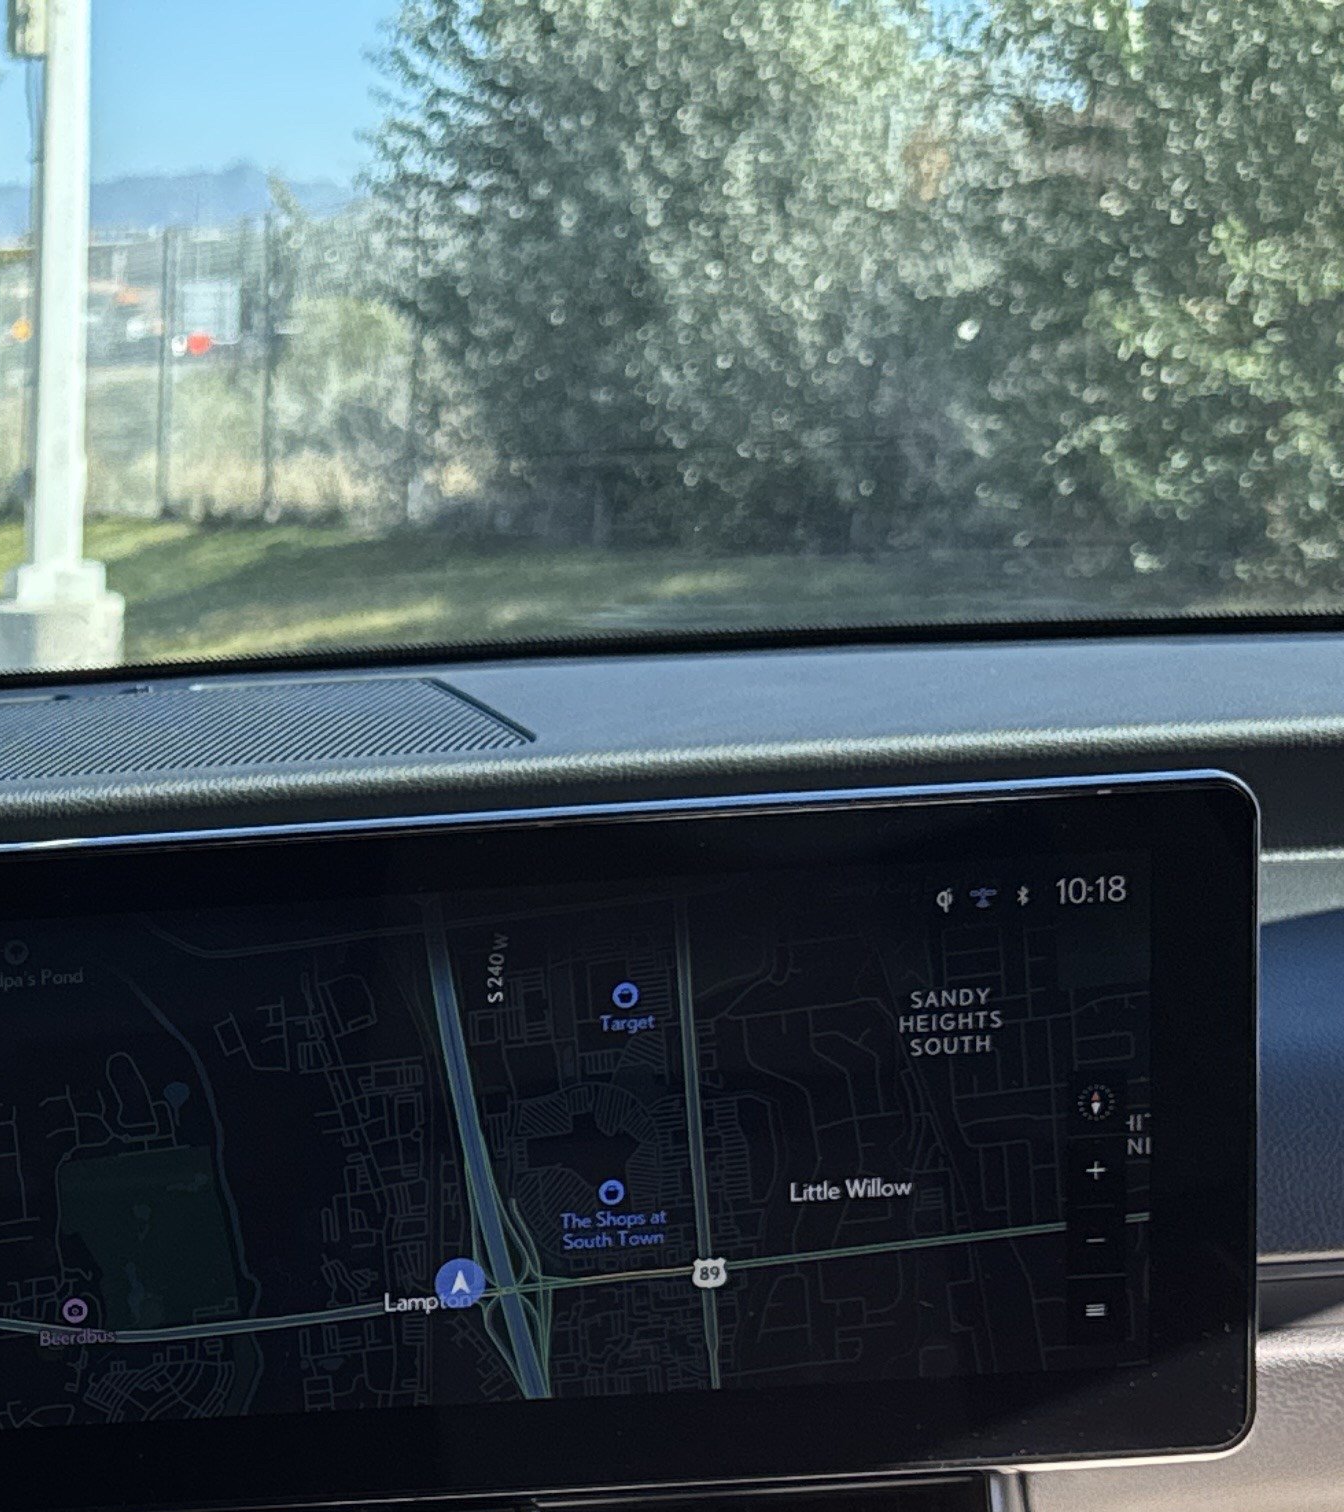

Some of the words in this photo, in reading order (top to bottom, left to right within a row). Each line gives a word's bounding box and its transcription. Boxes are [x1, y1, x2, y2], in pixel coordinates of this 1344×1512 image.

[1057, 876, 1127, 905] 10:18
[494, 932, 510, 951] W
[40, 967, 85, 986] Pond
[488, 953, 507, 984] 240
[488, 986, 505, 1004] S
[910, 987, 992, 1010] SANDY
[599, 1014, 657, 1034] Target
[898, 1010, 1004, 1034] HEIGHTS
[910, 1035, 993, 1057] SOUTH
[790, 1180, 842, 1203] Little
[844, 1176, 913, 1200] Willow
[560, 1211, 596, 1229] The
[599, 1210, 647, 1230] Shops
[650, 1210, 668, 1226] at
[562, 1233, 612, 1251] South
[619, 1231, 666, 1249] Town
[698, 1266, 721, 1282] 89
